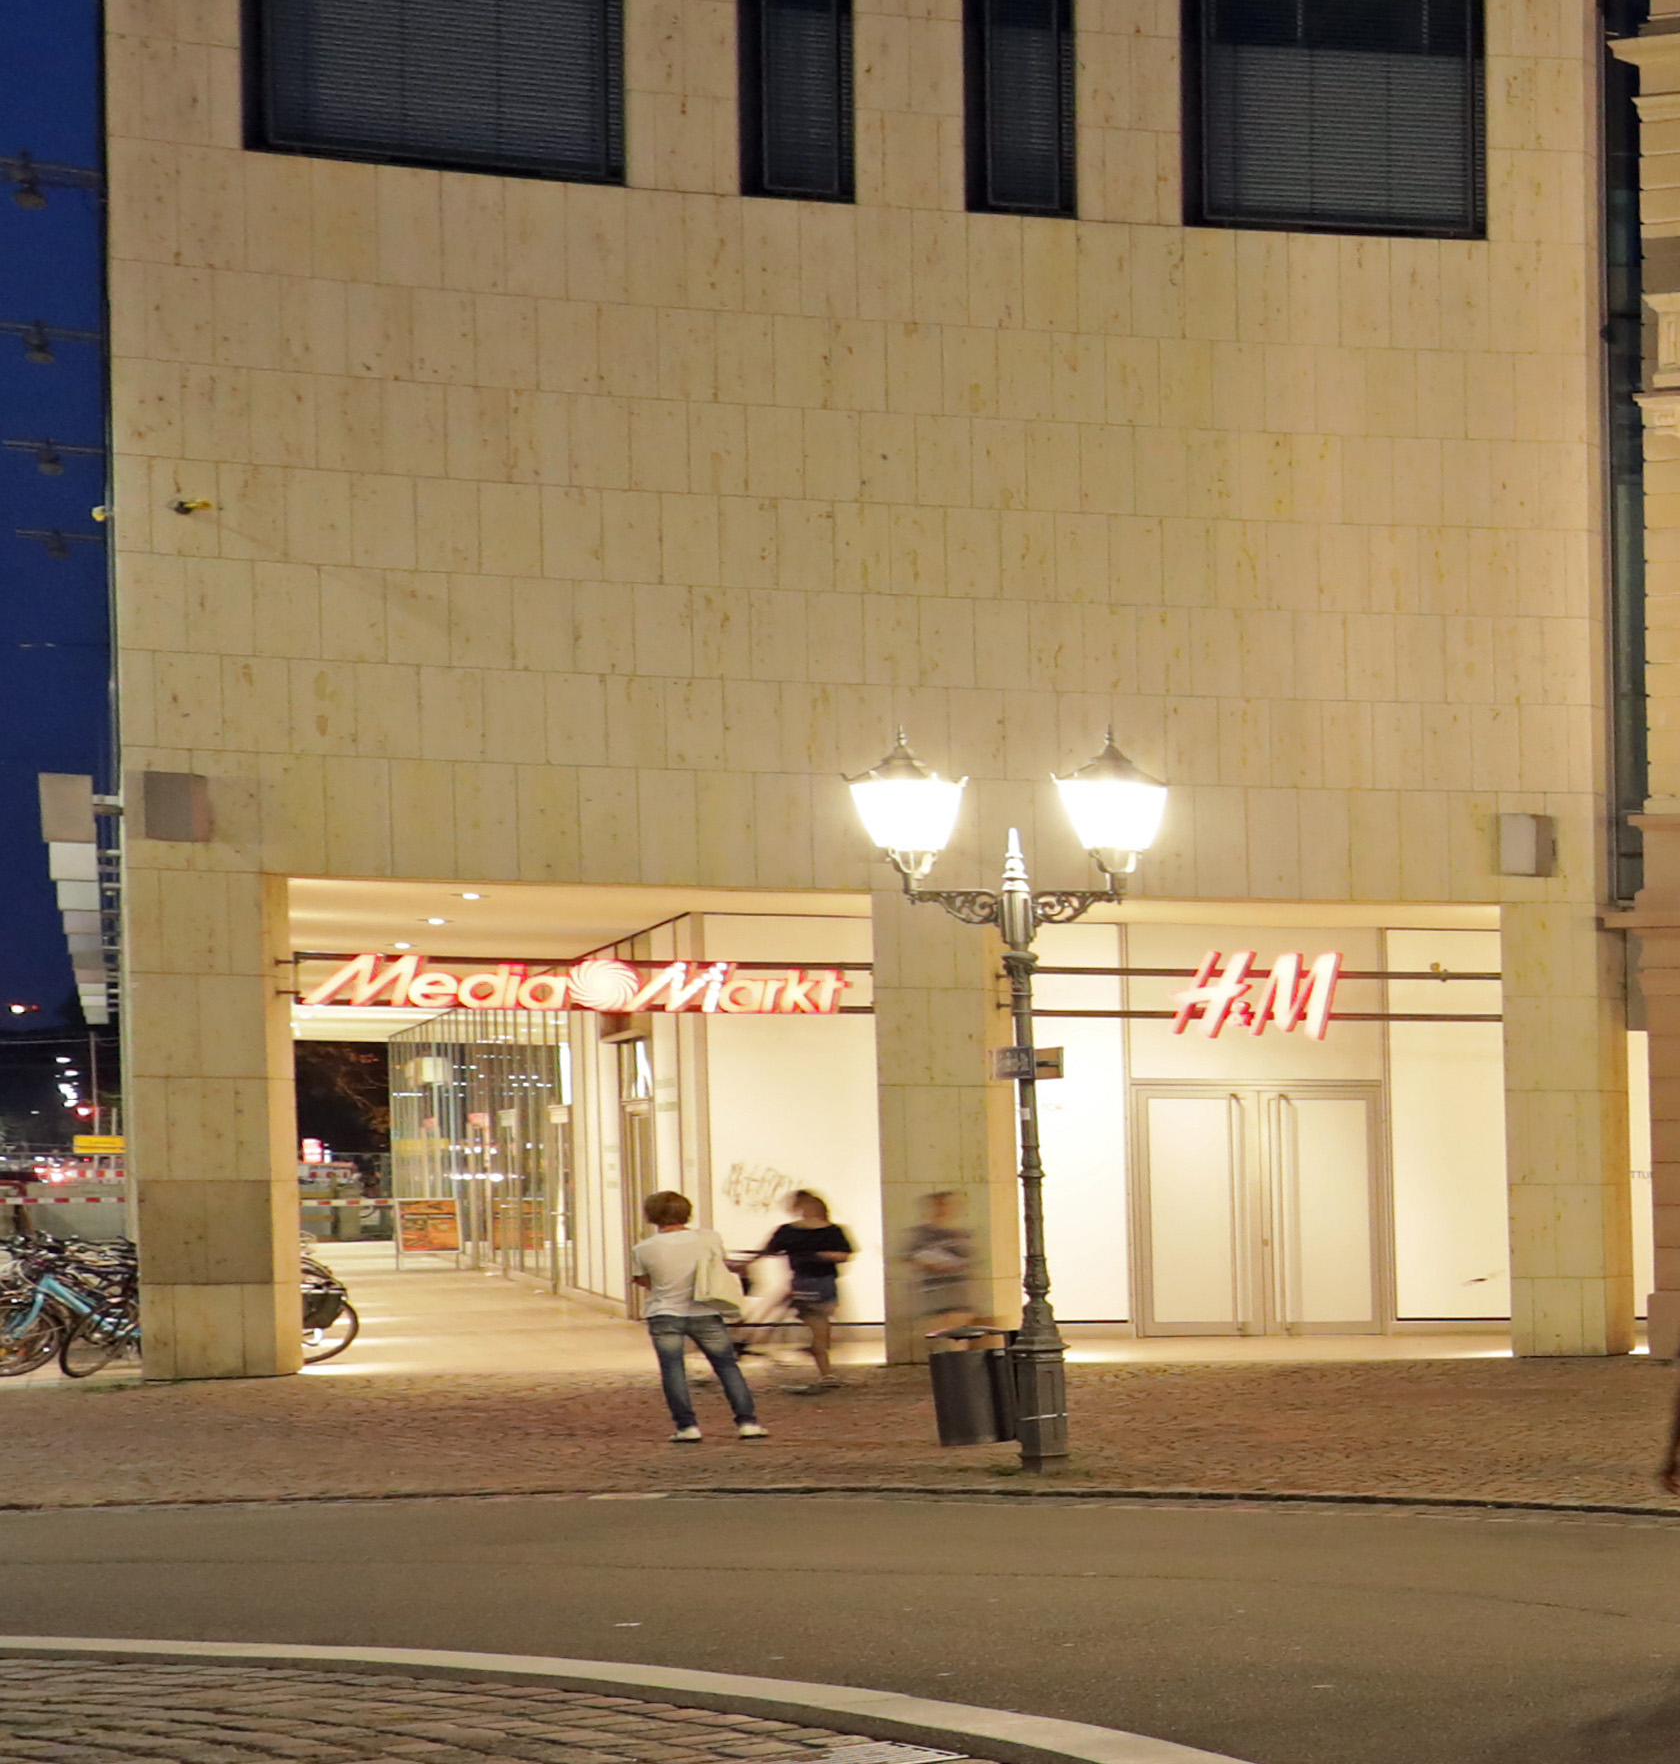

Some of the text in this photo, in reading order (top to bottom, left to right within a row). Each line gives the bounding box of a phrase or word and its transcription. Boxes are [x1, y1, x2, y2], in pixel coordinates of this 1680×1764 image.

[302, 952, 852, 1014] Media Markt
[1168, 950, 1344, 1041] H&M
